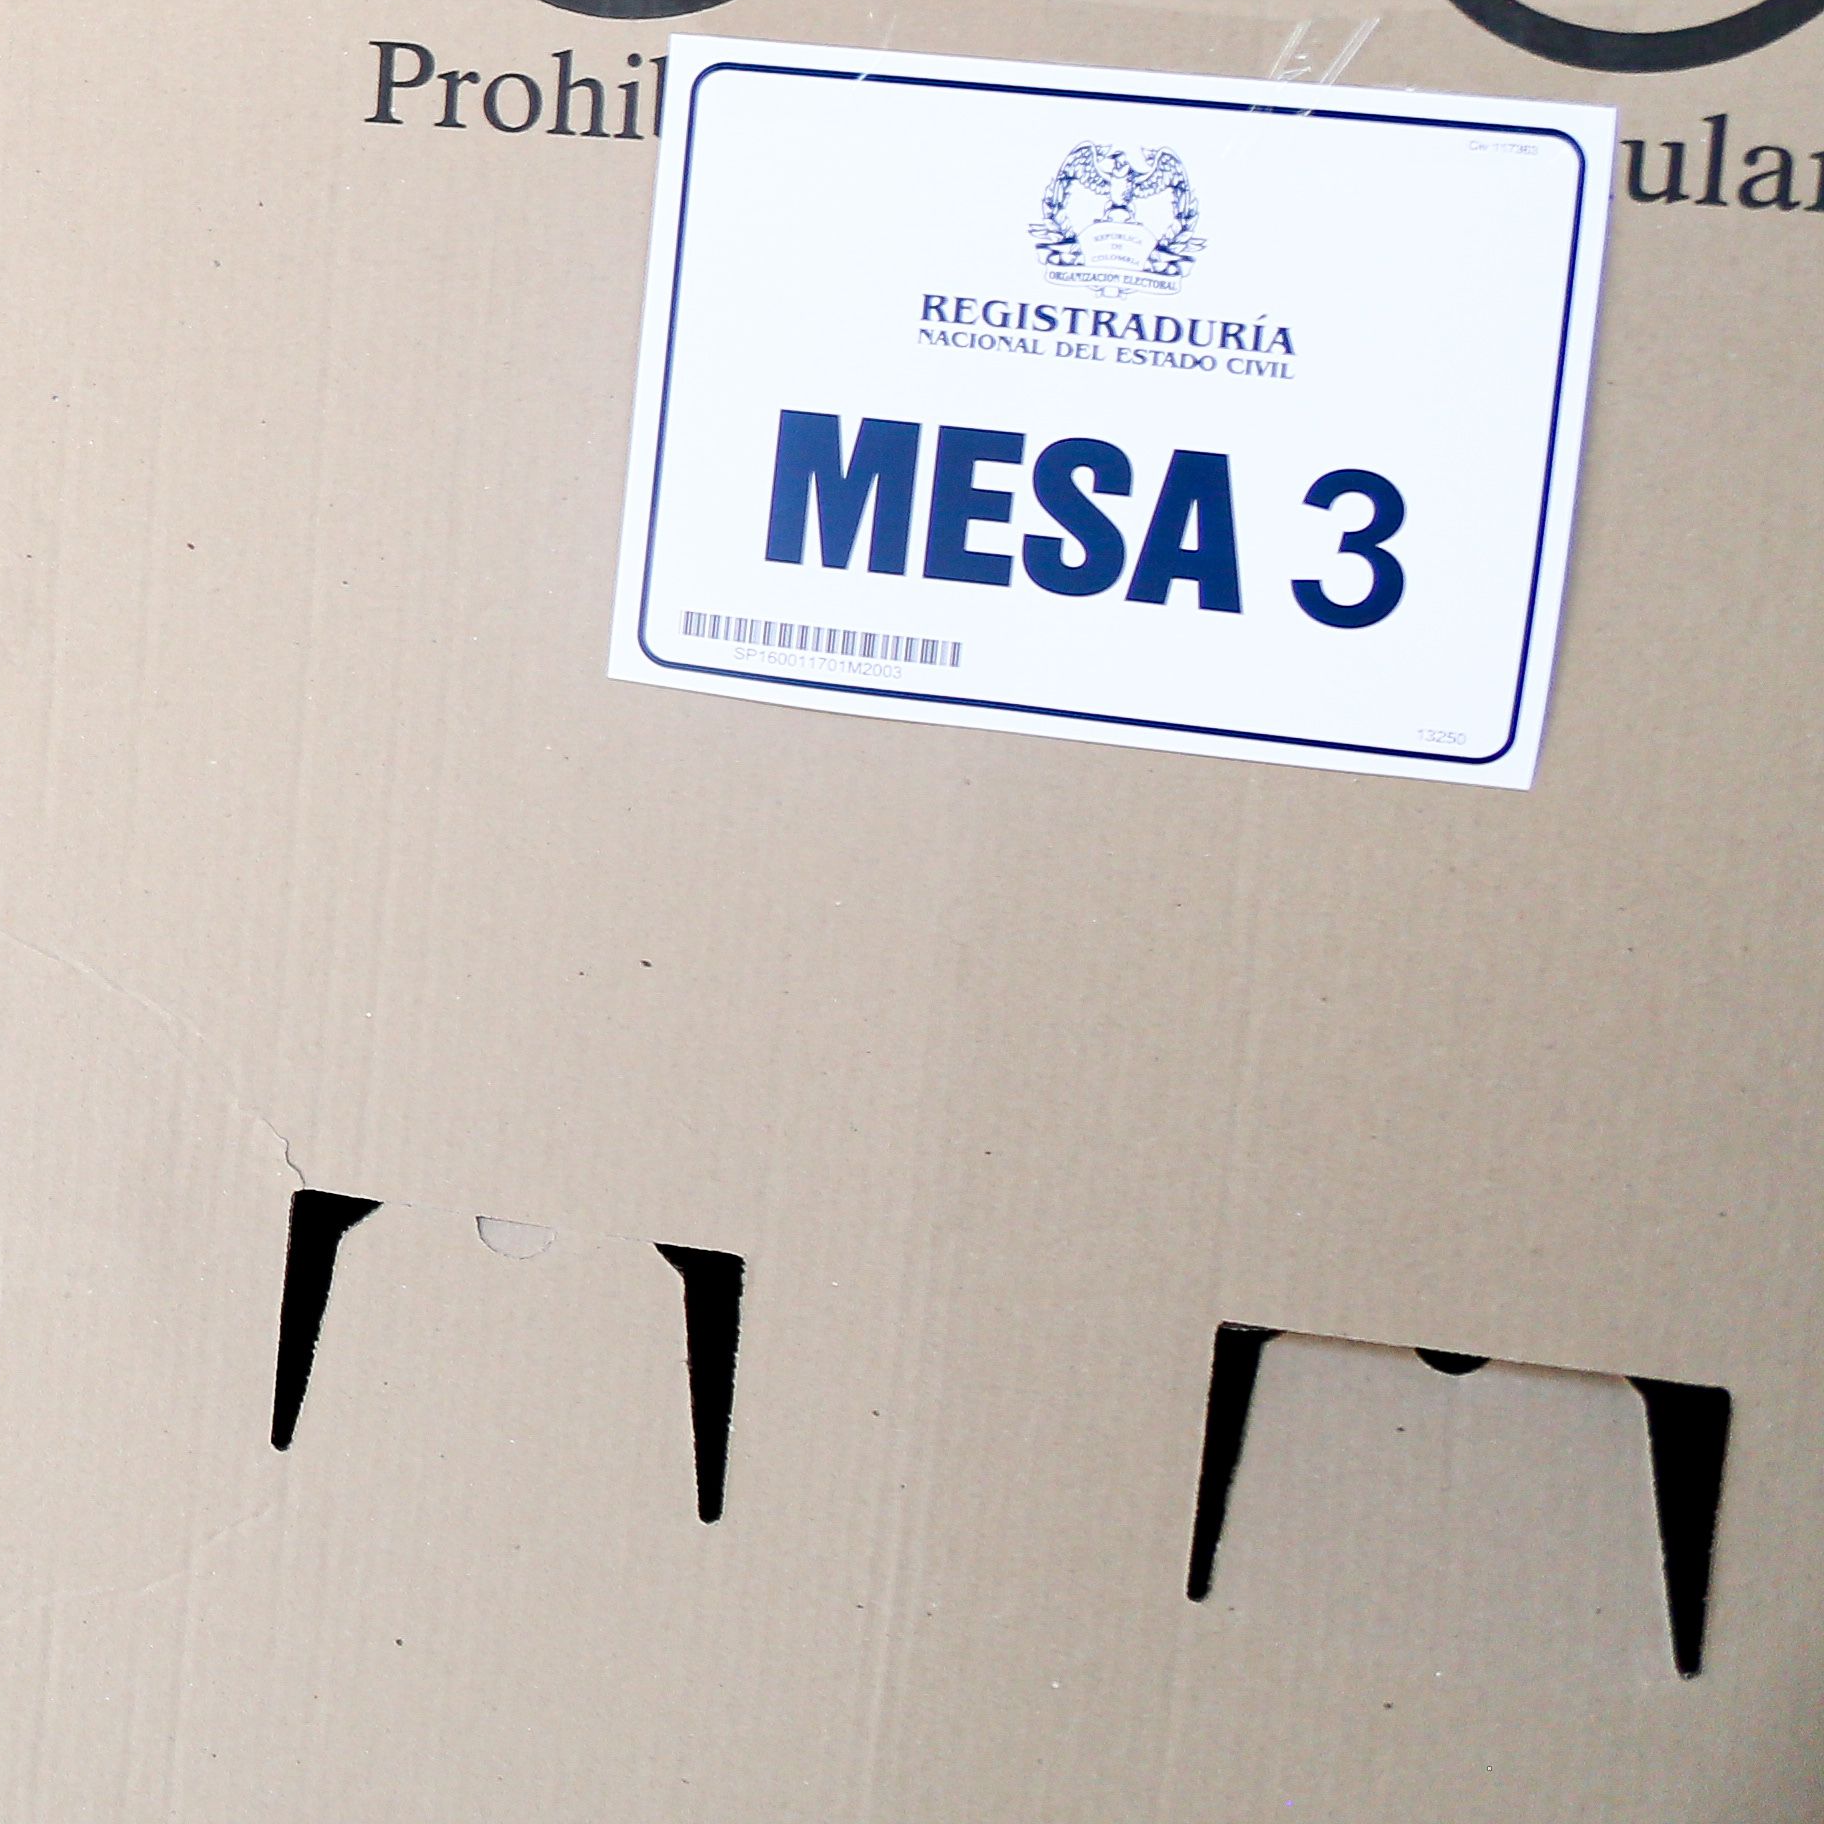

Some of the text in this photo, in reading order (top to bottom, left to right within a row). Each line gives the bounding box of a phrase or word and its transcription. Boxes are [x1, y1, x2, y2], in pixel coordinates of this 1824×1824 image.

[1609, 113, 1824, 213] ula
[1123, 276, 1178, 291] ELECTORAL
[918, 328, 1295, 380] NACIONAL DEL ESTADO CIVIL
[919, 293, 1296, 356] REGISTRADURÍA
[765, 409, 1408, 629] MESA 3
